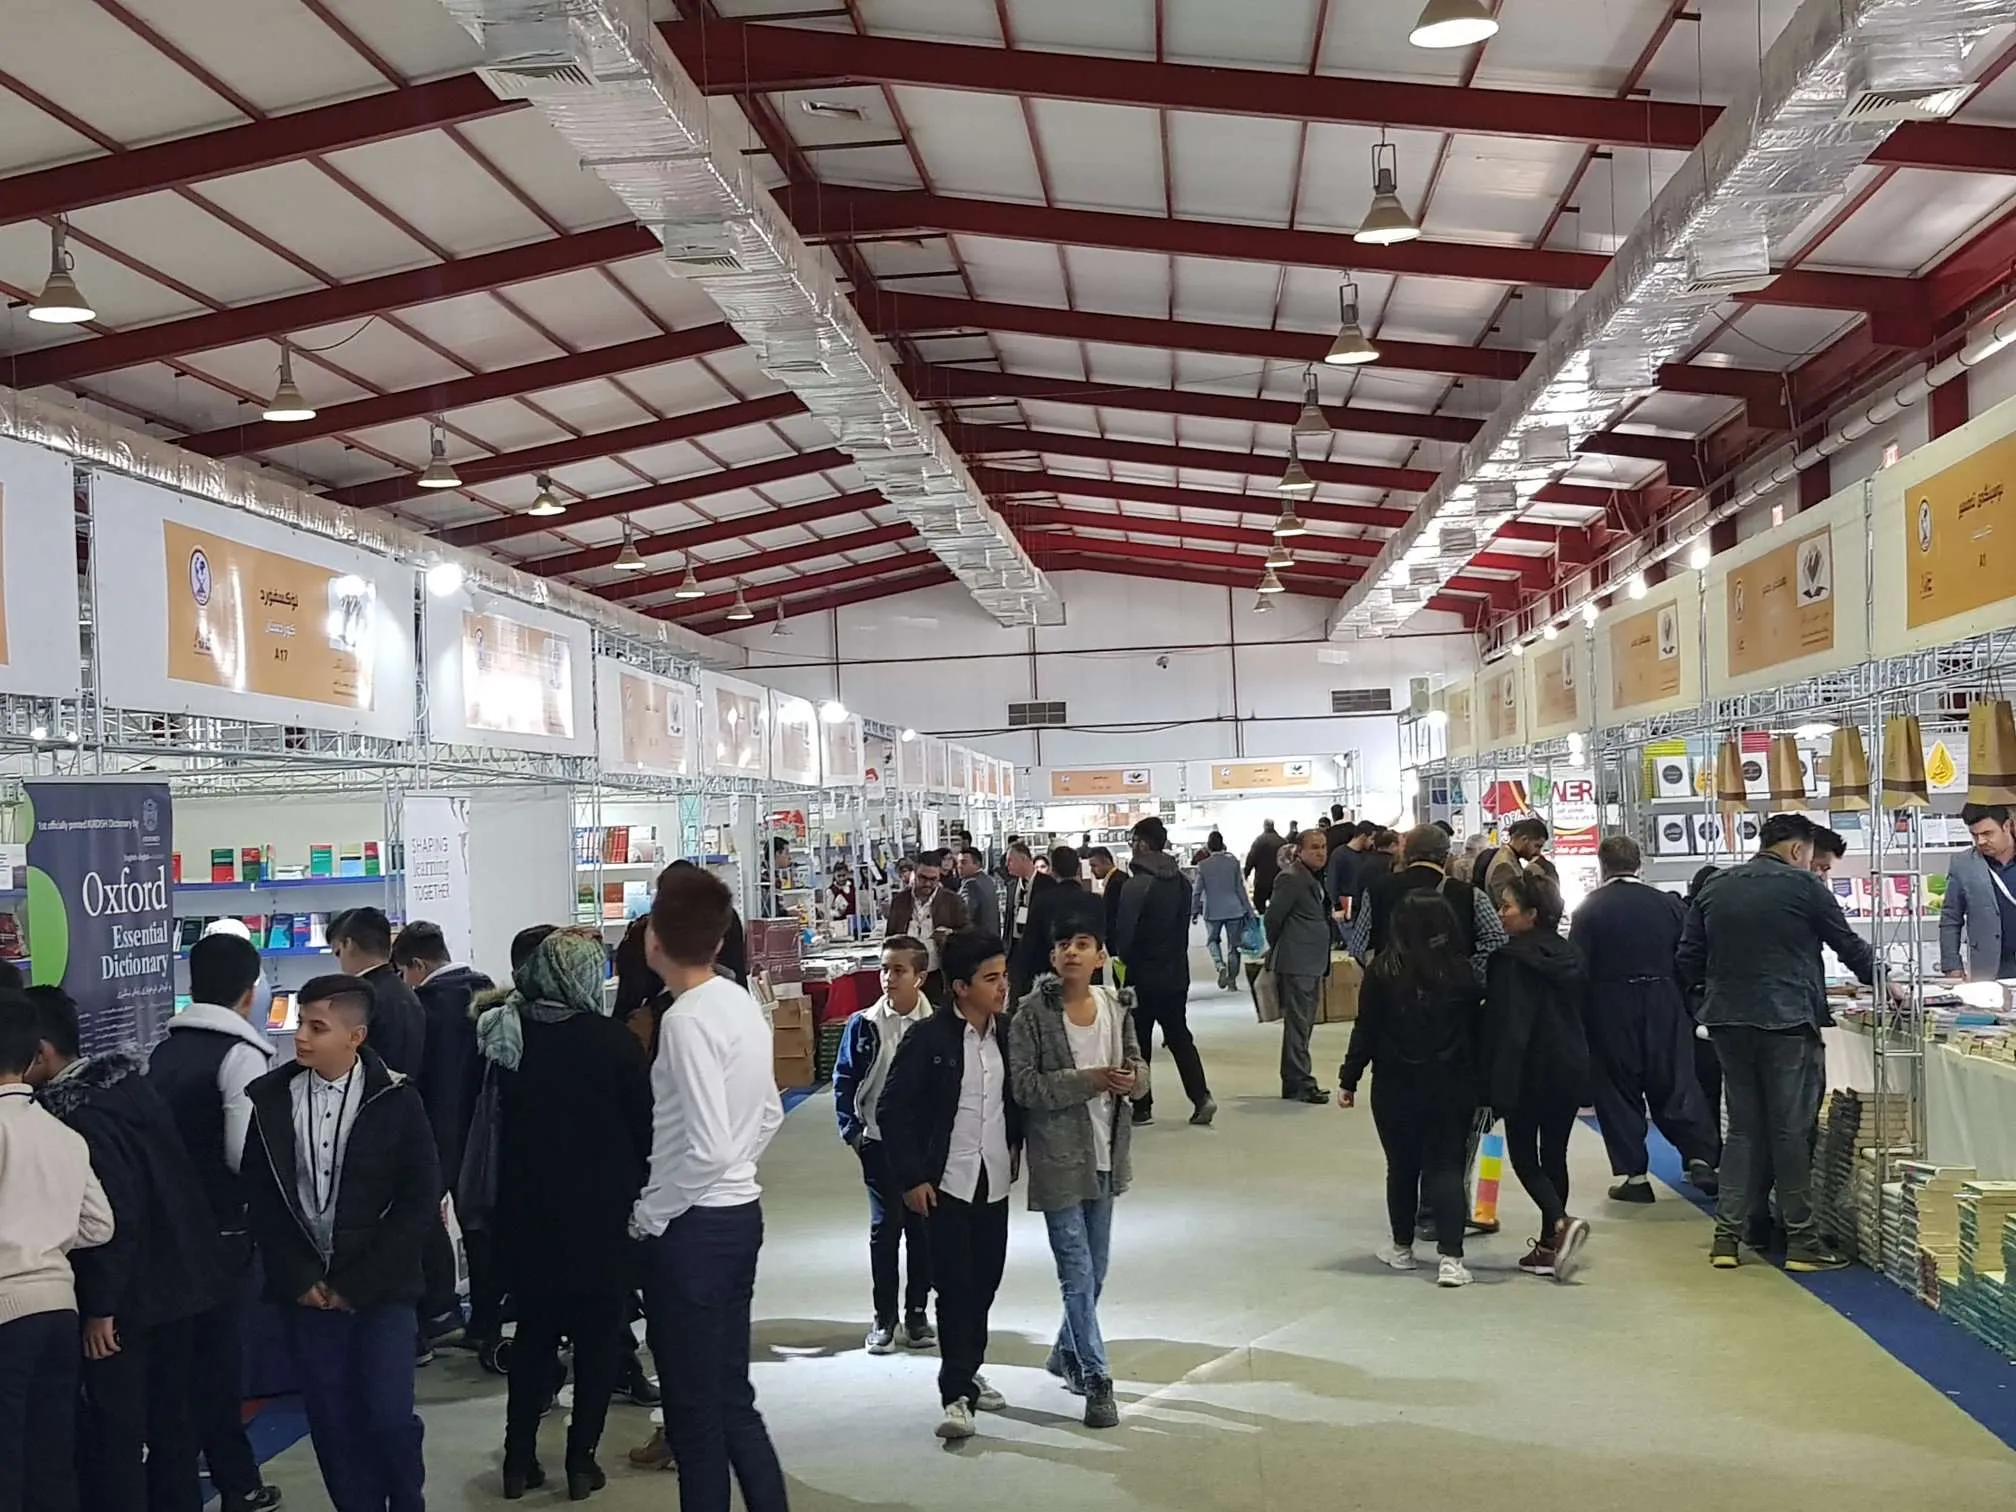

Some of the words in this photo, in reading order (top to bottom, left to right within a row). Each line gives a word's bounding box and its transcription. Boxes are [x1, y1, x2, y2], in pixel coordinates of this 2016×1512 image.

[274, 647, 289, 662] A17
[82, 864, 168, 917] Oxford
[112, 919, 168, 950] Essential
[101, 952, 169, 980] Dictionary
